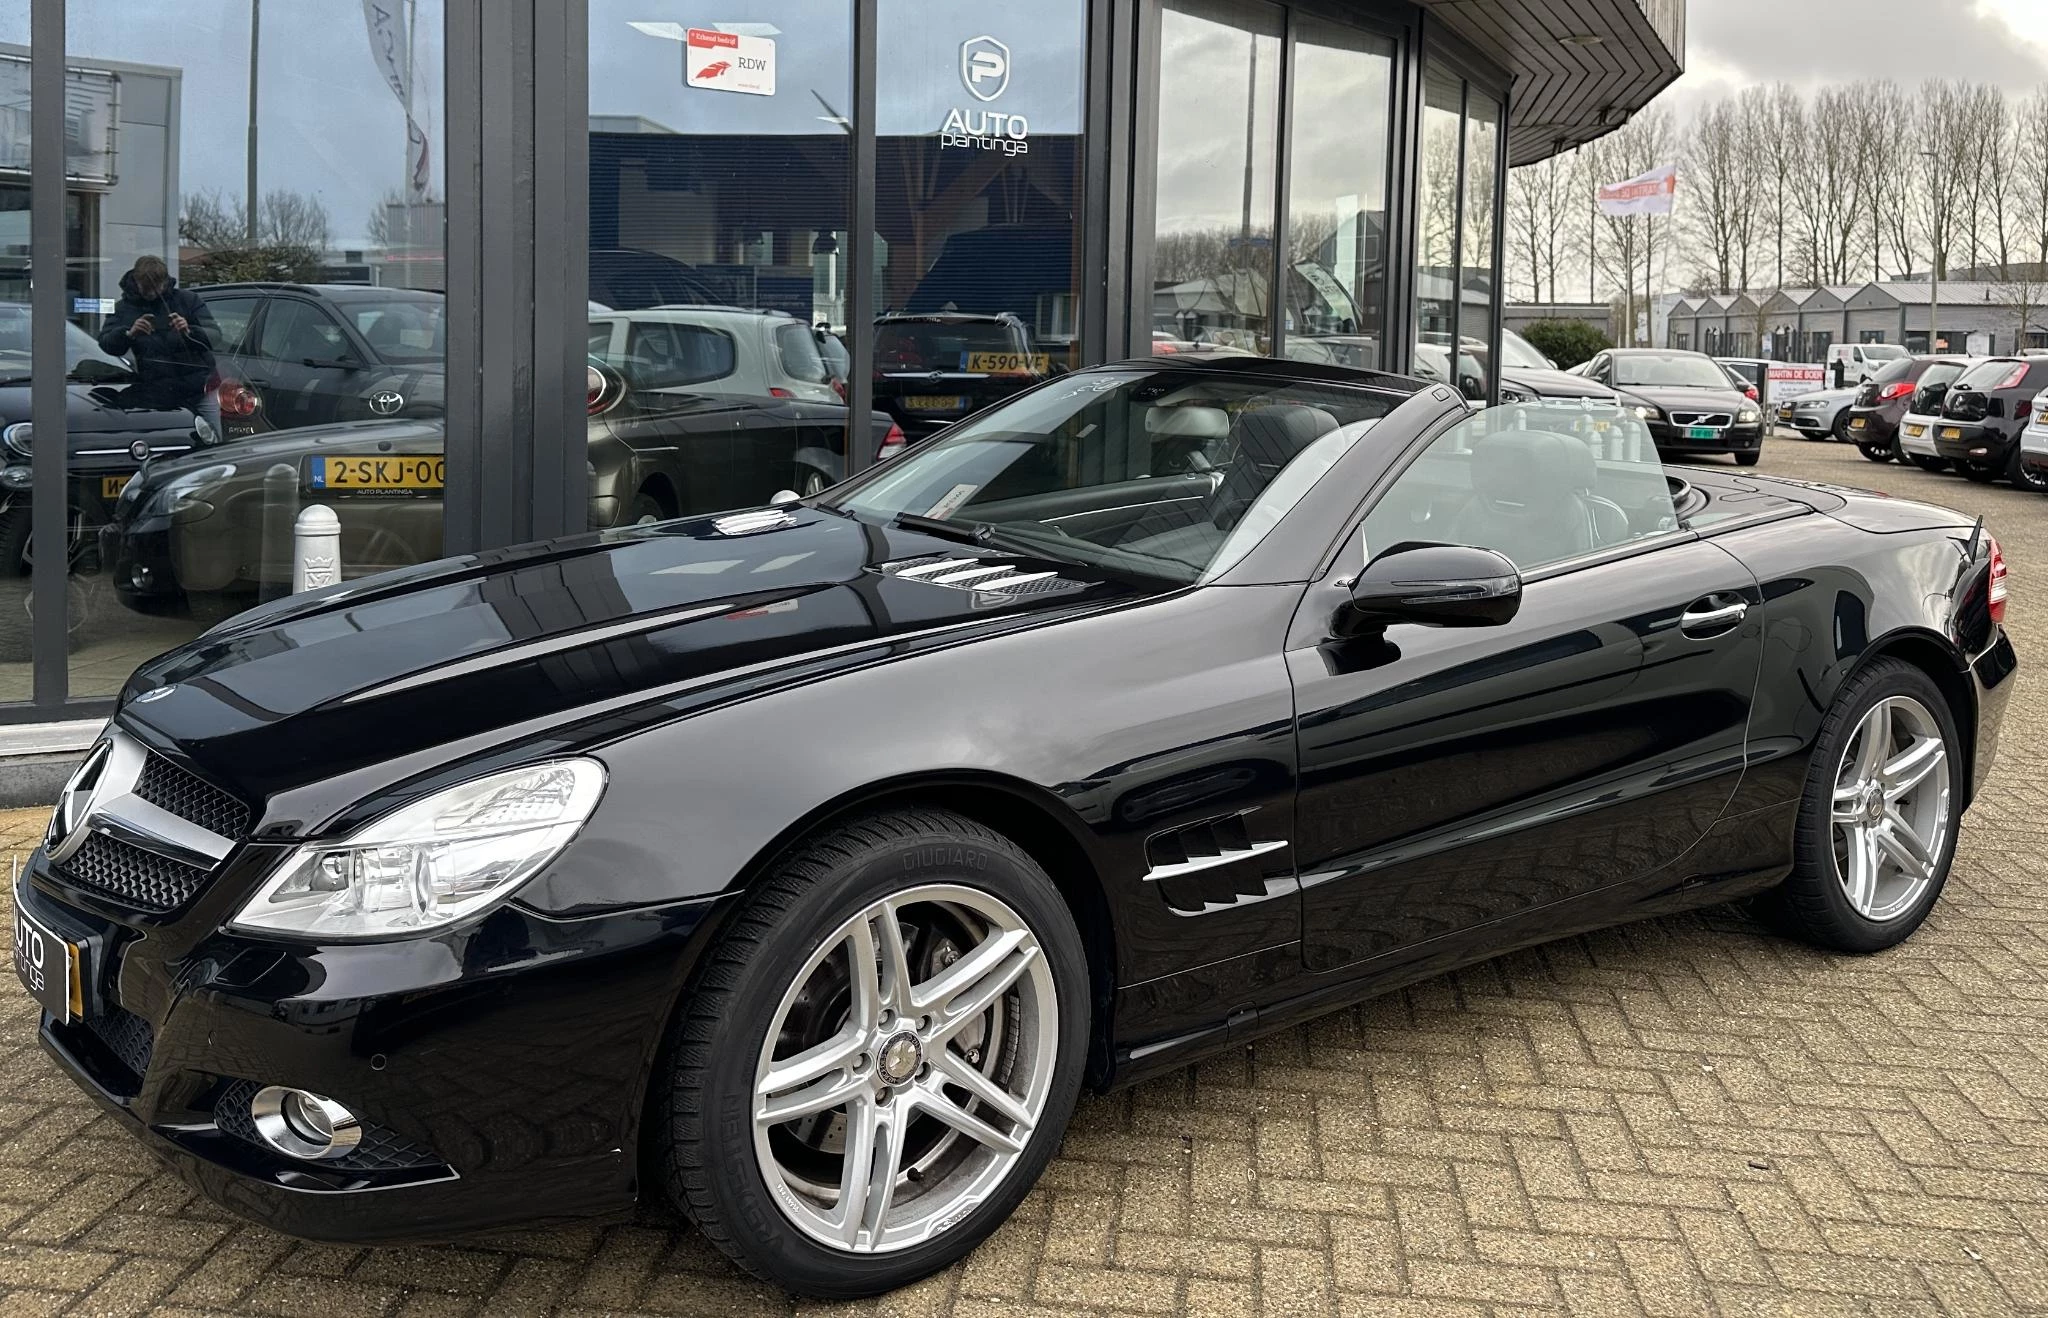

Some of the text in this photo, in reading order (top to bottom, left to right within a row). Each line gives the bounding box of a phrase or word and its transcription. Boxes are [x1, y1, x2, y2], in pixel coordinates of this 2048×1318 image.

[738, 56, 767, 71] RDW
[942, 108, 1028, 140] AUTO
[941, 132, 1028, 156] plantinga
[1794, 370, 1803, 378] DE
[903, 848, 988, 870] GIUGIARO
